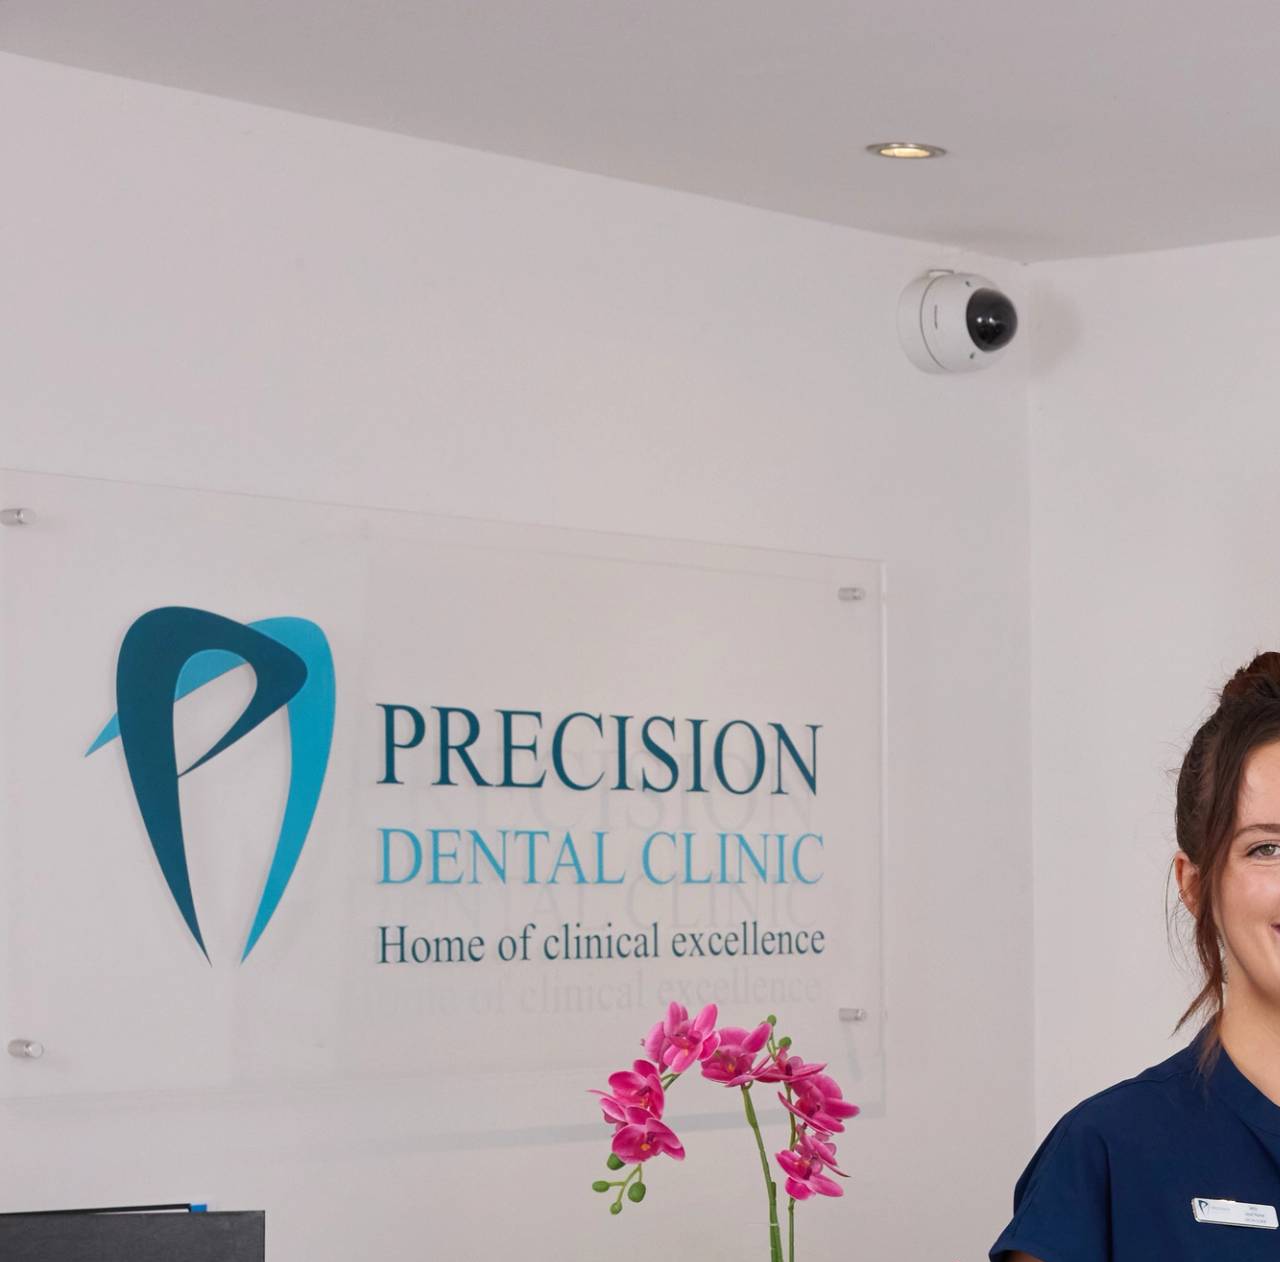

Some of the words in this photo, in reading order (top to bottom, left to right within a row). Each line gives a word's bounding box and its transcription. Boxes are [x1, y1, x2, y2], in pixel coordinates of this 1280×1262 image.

[375, 702, 824, 797] PRECISION
[376, 827, 626, 885] DENTAL
[641, 832, 825, 885] CLINIC
[376, 925, 485, 964] Home
[498, 923, 537, 961] of
[543, 922, 660, 961] clinical
[671, 921, 826, 958] excellence
